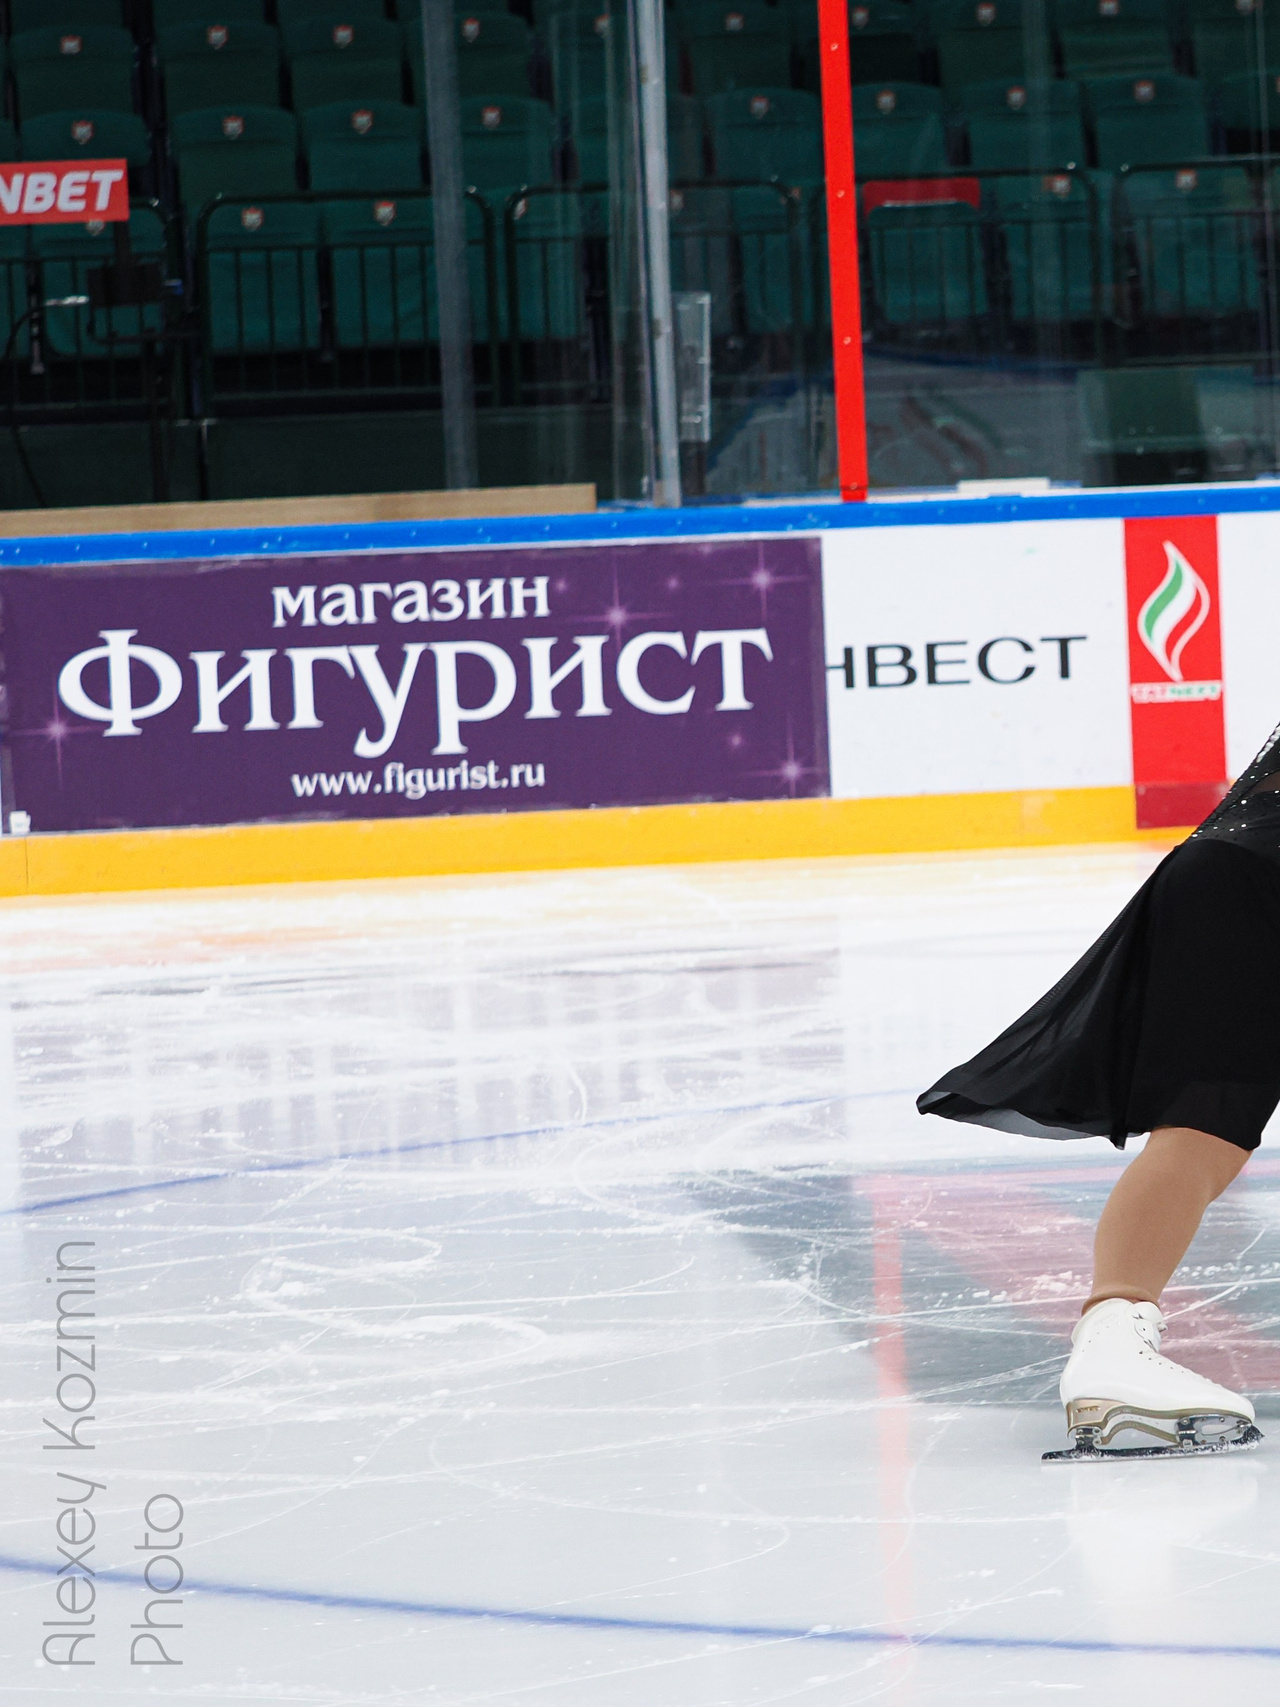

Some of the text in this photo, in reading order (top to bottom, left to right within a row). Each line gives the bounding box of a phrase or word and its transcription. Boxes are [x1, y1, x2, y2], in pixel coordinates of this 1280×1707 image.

[272, 576, 551, 628] магазин
[57, 628, 775, 759] Фигурист
[290, 759, 546, 800] www.figurist.ru
